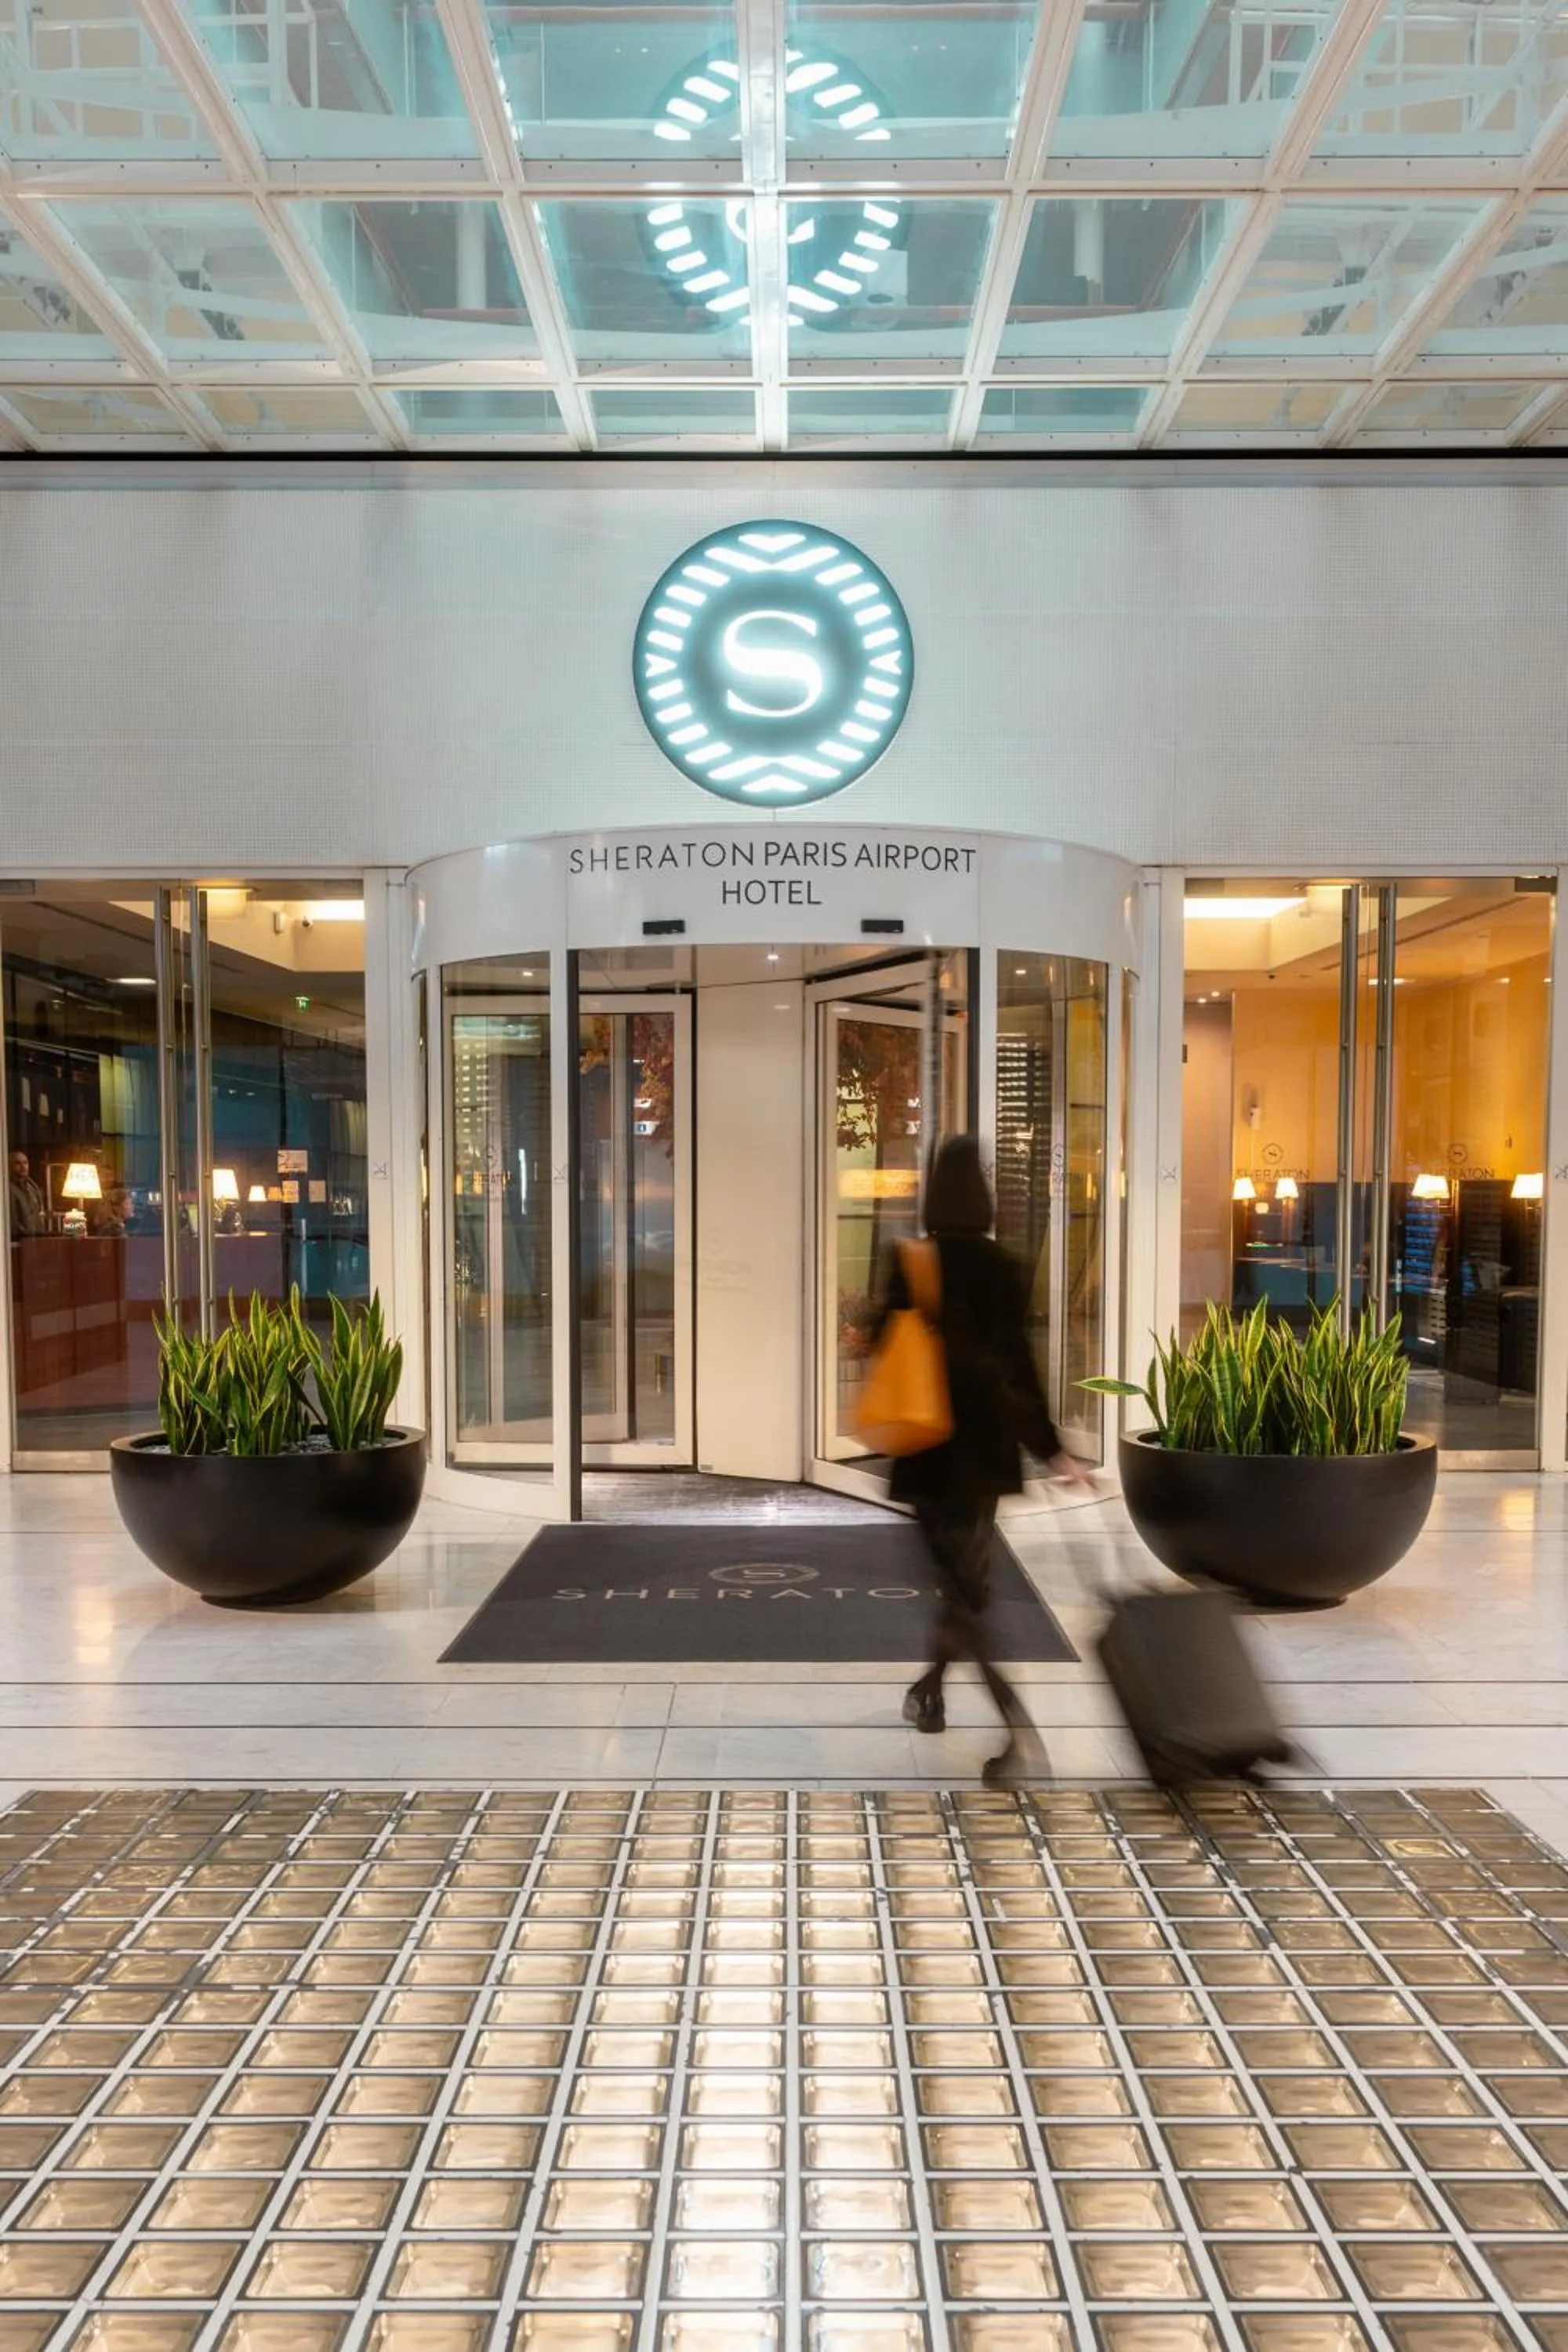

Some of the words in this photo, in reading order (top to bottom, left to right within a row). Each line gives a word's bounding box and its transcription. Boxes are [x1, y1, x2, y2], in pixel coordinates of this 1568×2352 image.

[722, 609, 823, 718] S
[568, 840, 754, 874] SHERATON
[764, 841, 848, 867] PARIS
[854, 843, 977, 873] AIRPORT
[721, 879, 822, 906] HOTEL
